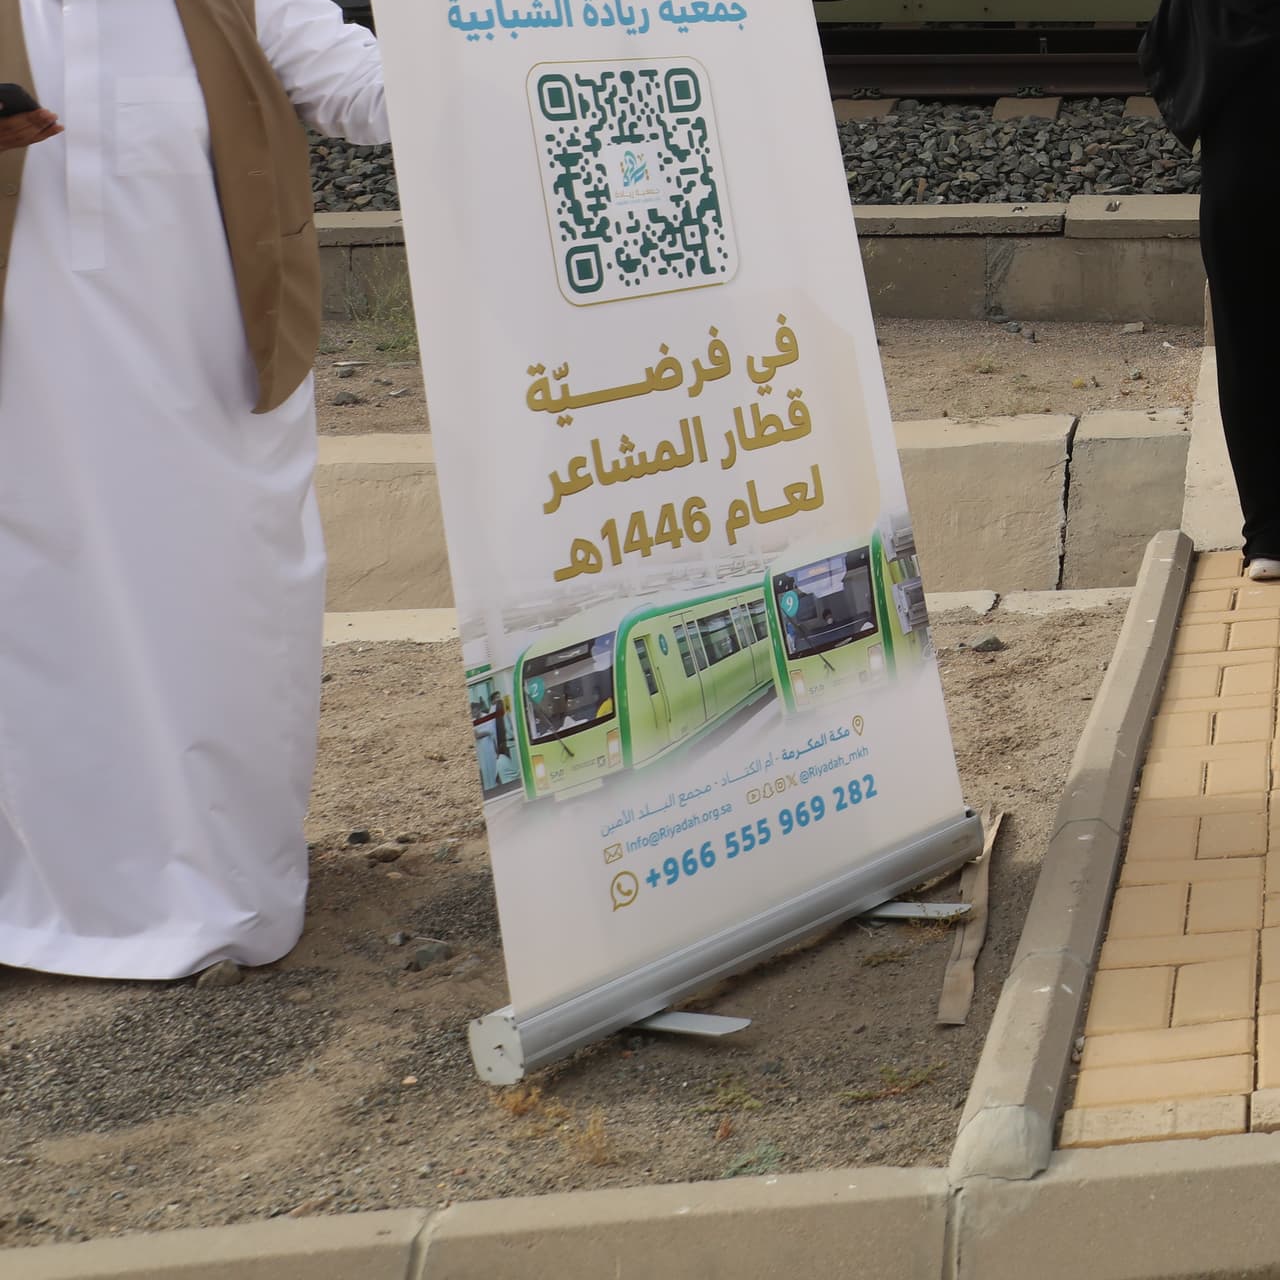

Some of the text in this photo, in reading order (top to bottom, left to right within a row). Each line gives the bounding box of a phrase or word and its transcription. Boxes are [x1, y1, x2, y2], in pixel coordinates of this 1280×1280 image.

[746, 312, 800, 397] في
[543, 387, 812, 515] قطار المشاعر
[725, 463, 825, 546] لعام
[785, 595, 794, 612] 9
[781, 733, 828, 761] المكرمة
[829, 725, 850, 742] مكة
[799, 745, 869, 784] @Riyadah_mkh
[678, 784, 712, 808] مجمع
[645, 773, 879, 888] +966 555 969 282
